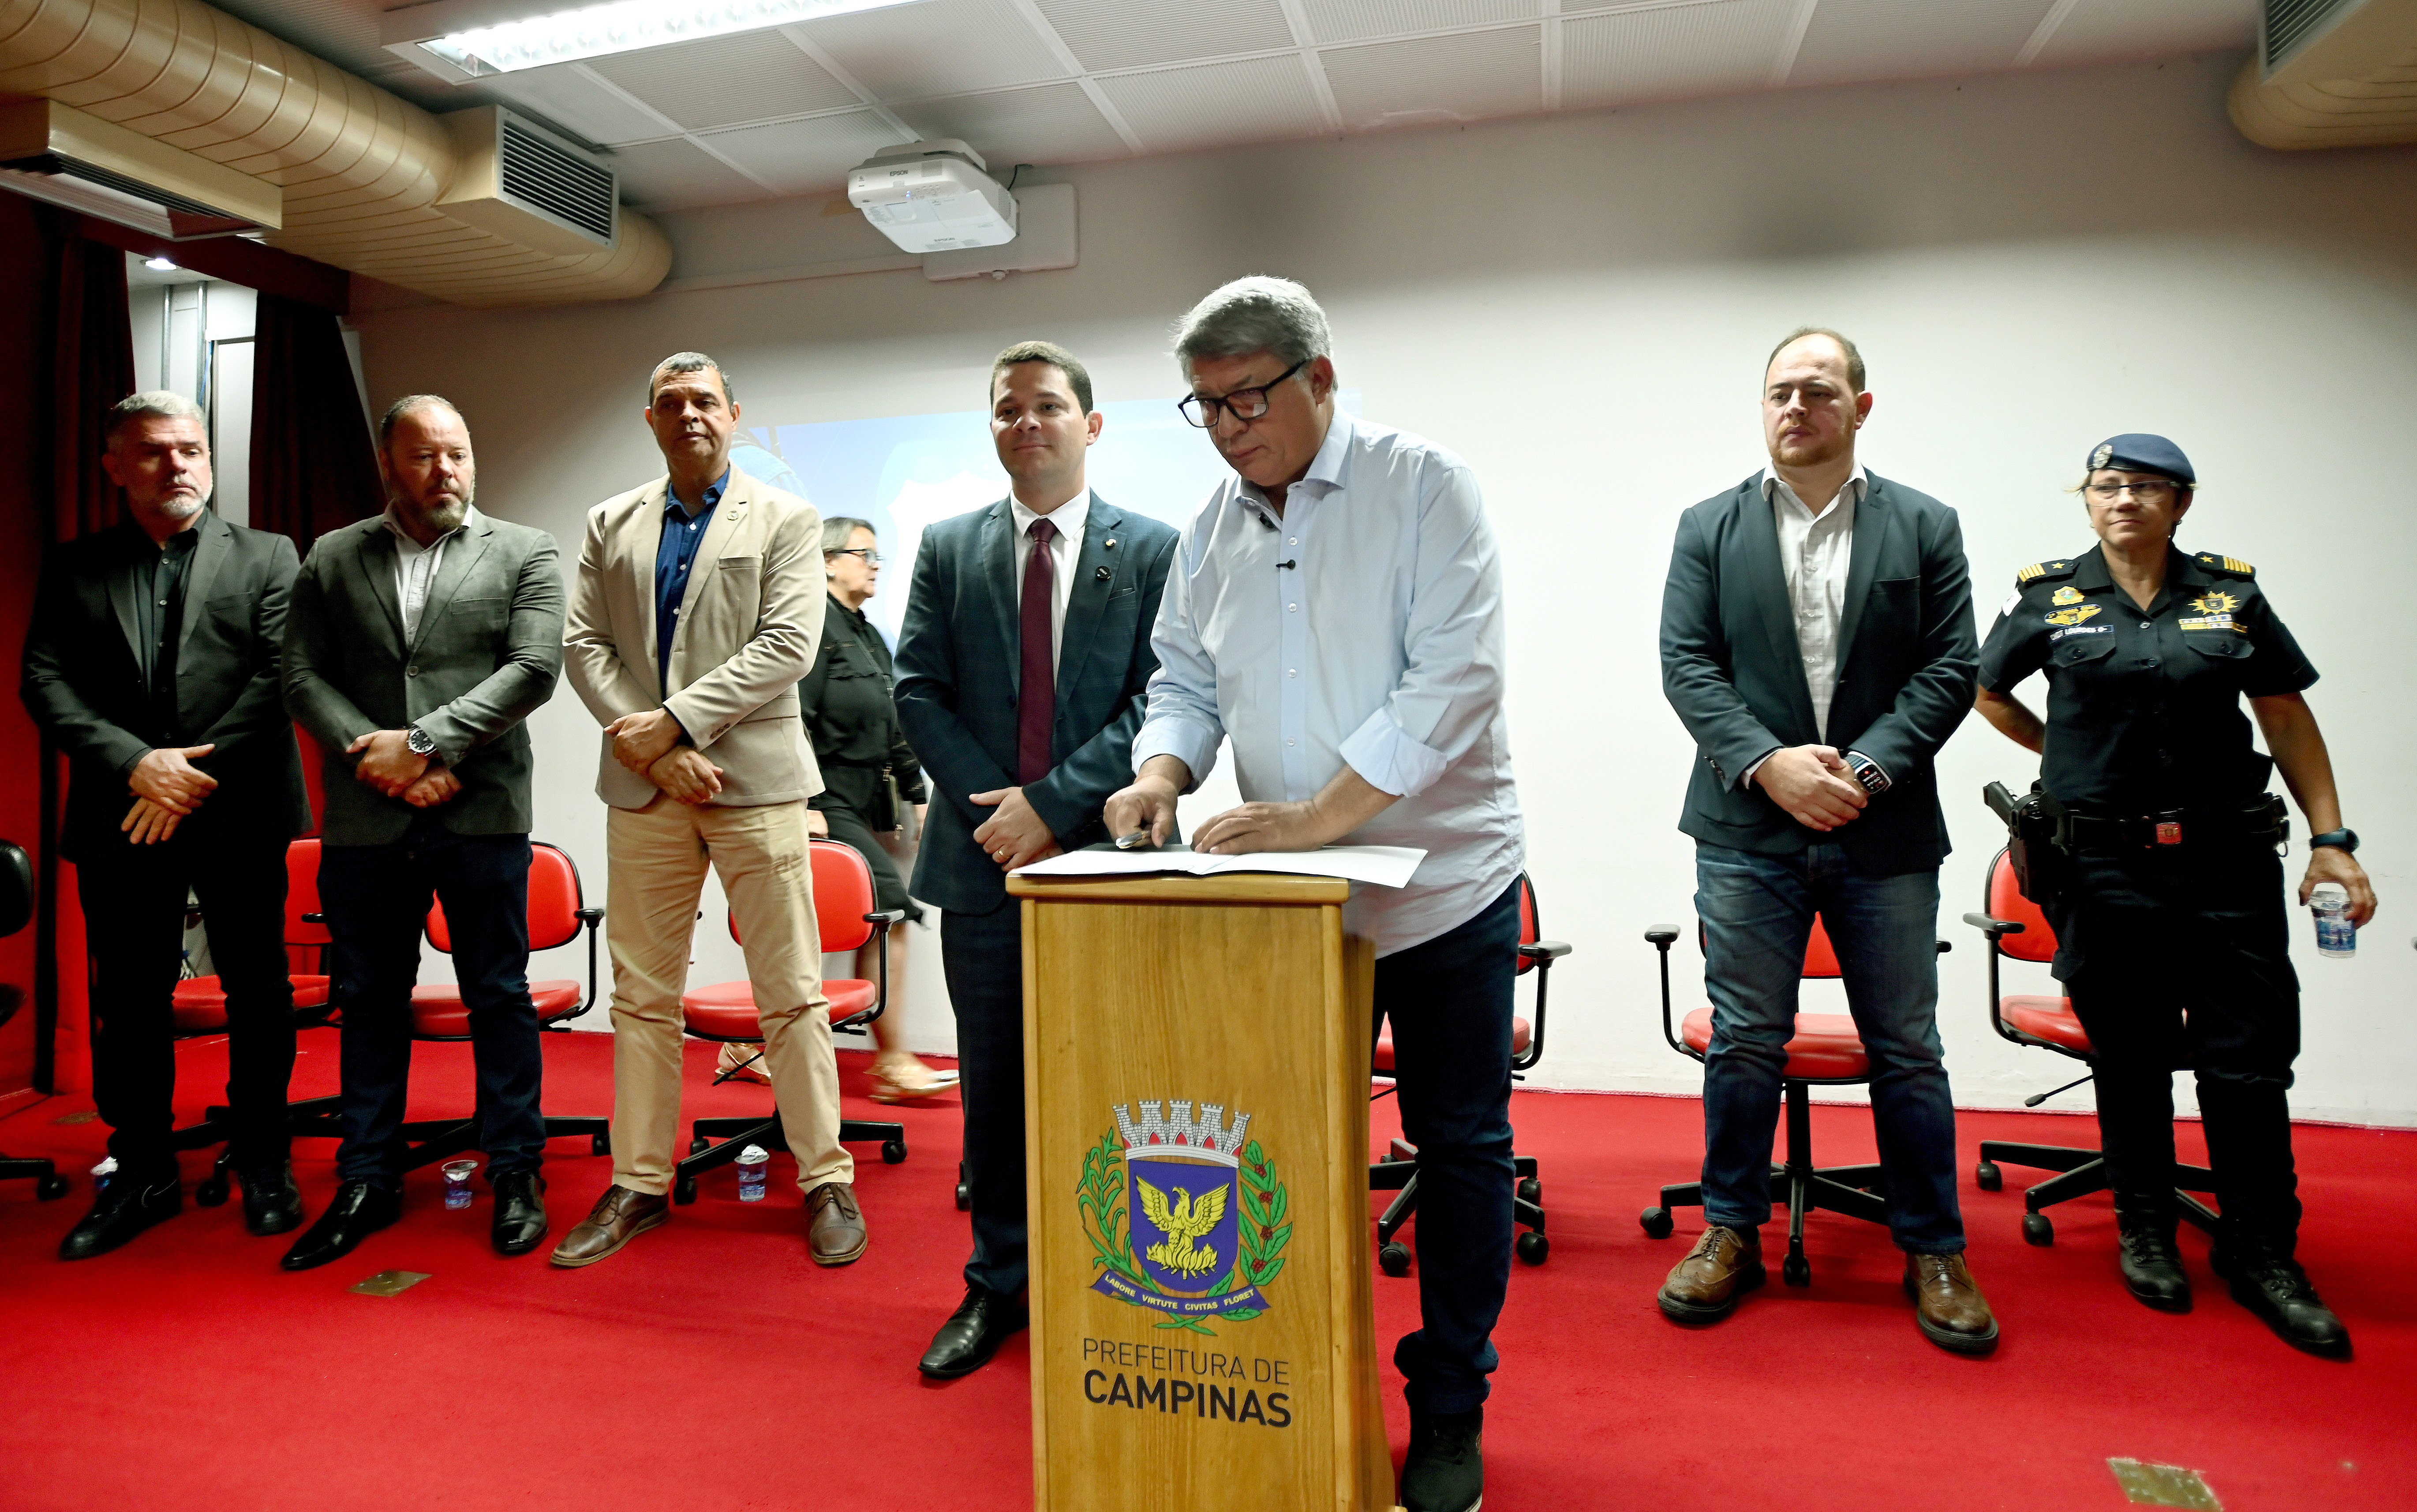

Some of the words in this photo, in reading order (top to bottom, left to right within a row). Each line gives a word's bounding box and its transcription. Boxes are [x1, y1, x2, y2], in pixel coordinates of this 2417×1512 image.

[1105, 1275, 1136, 1297] LABORE
[1142, 1295, 1178, 1309] VIRTUTE
[1185, 1302, 1218, 1311] CIVITAS
[1223, 1289, 1255, 1306] FLORET
[1083, 1338, 1246, 1380] PREFEITURA
[1255, 1358, 1290, 1385] DE
[1084, 1369, 1292, 1428] CAMPINAS
